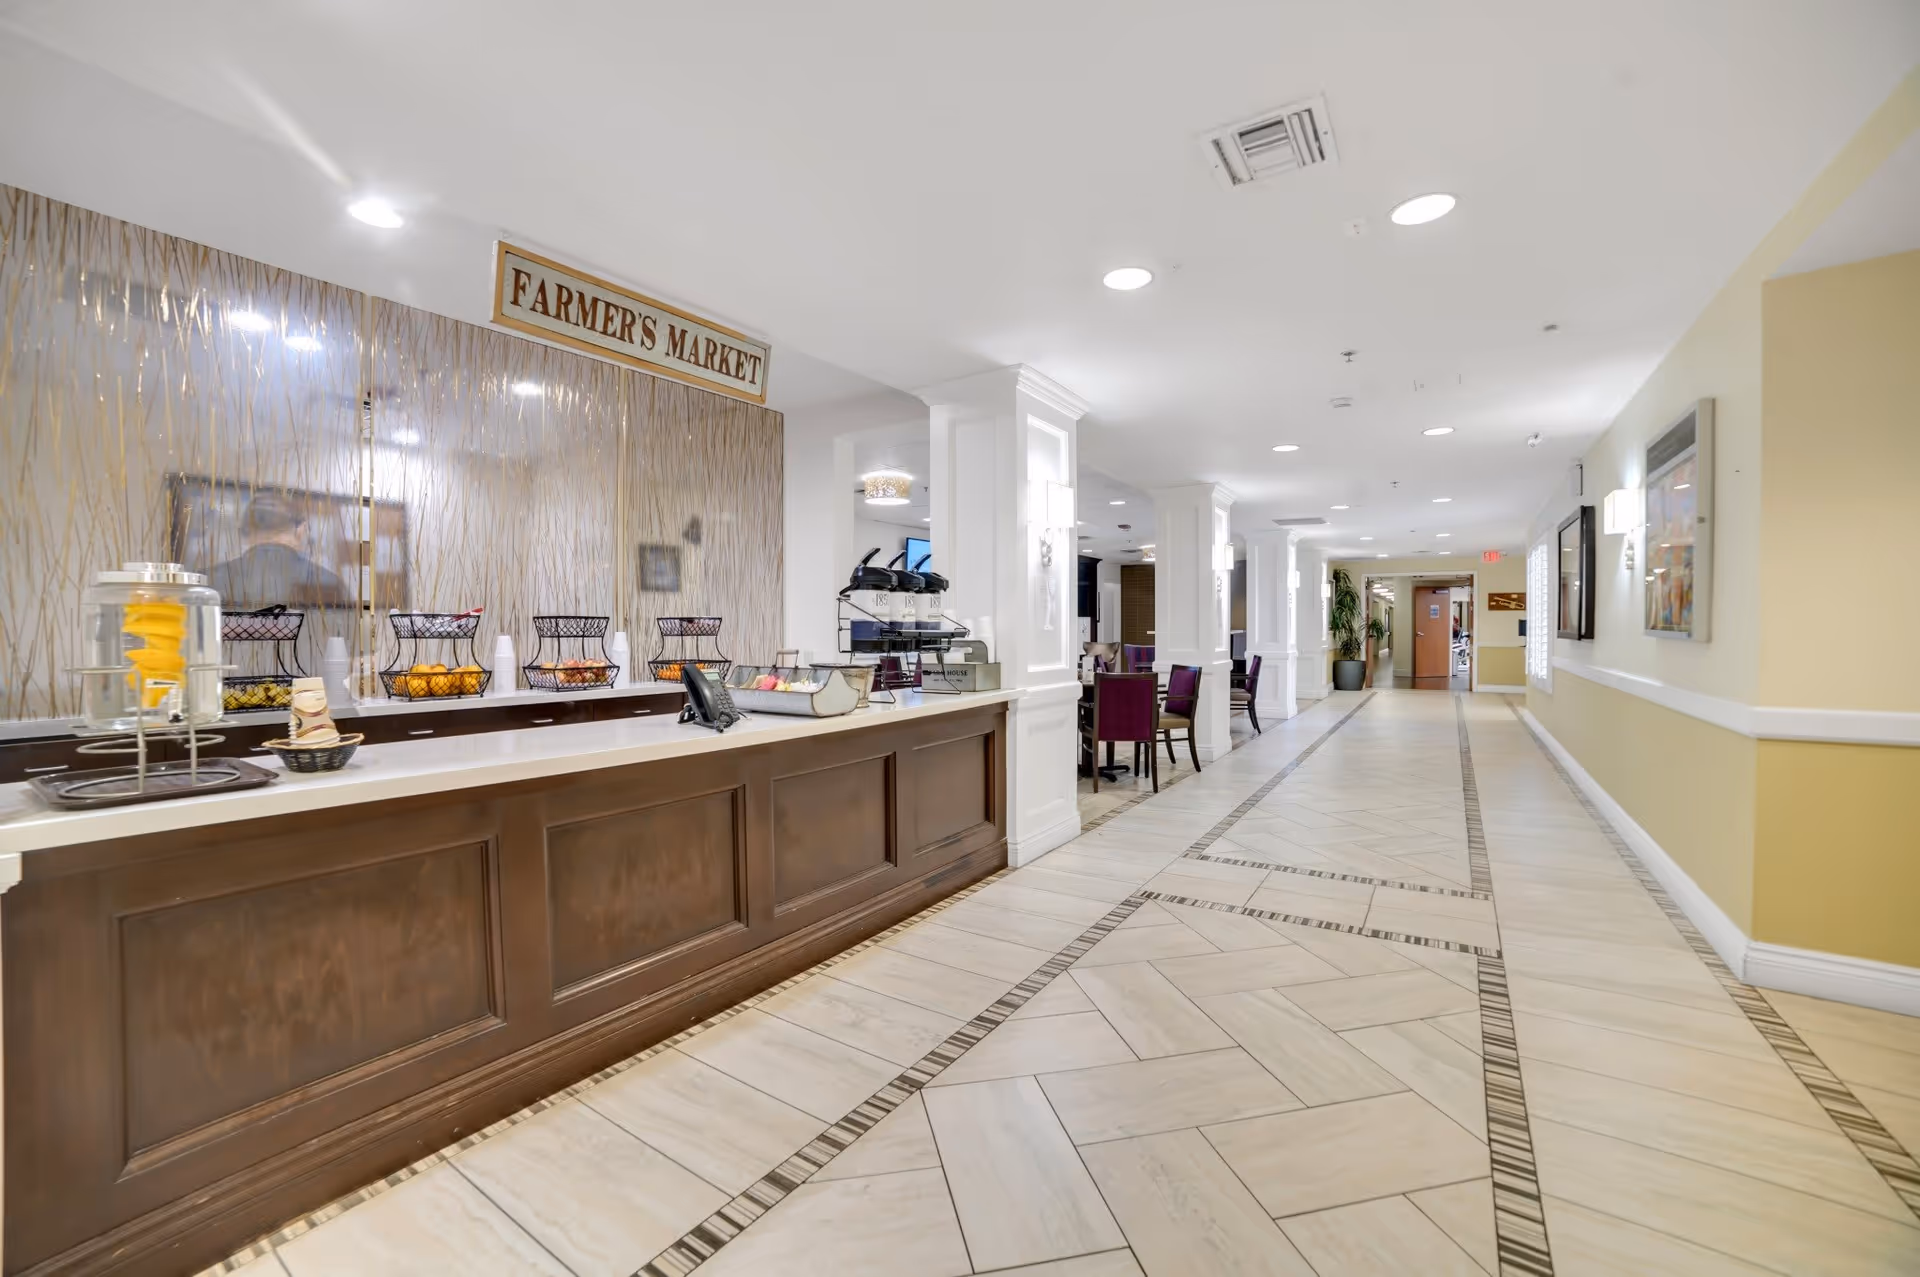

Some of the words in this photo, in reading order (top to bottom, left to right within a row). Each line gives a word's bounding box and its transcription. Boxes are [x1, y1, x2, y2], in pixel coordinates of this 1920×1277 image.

[510, 268, 656, 350] FARMER'S
[665, 324, 761, 384] MARKET
[947, 669, 968, 677] HOUSE
